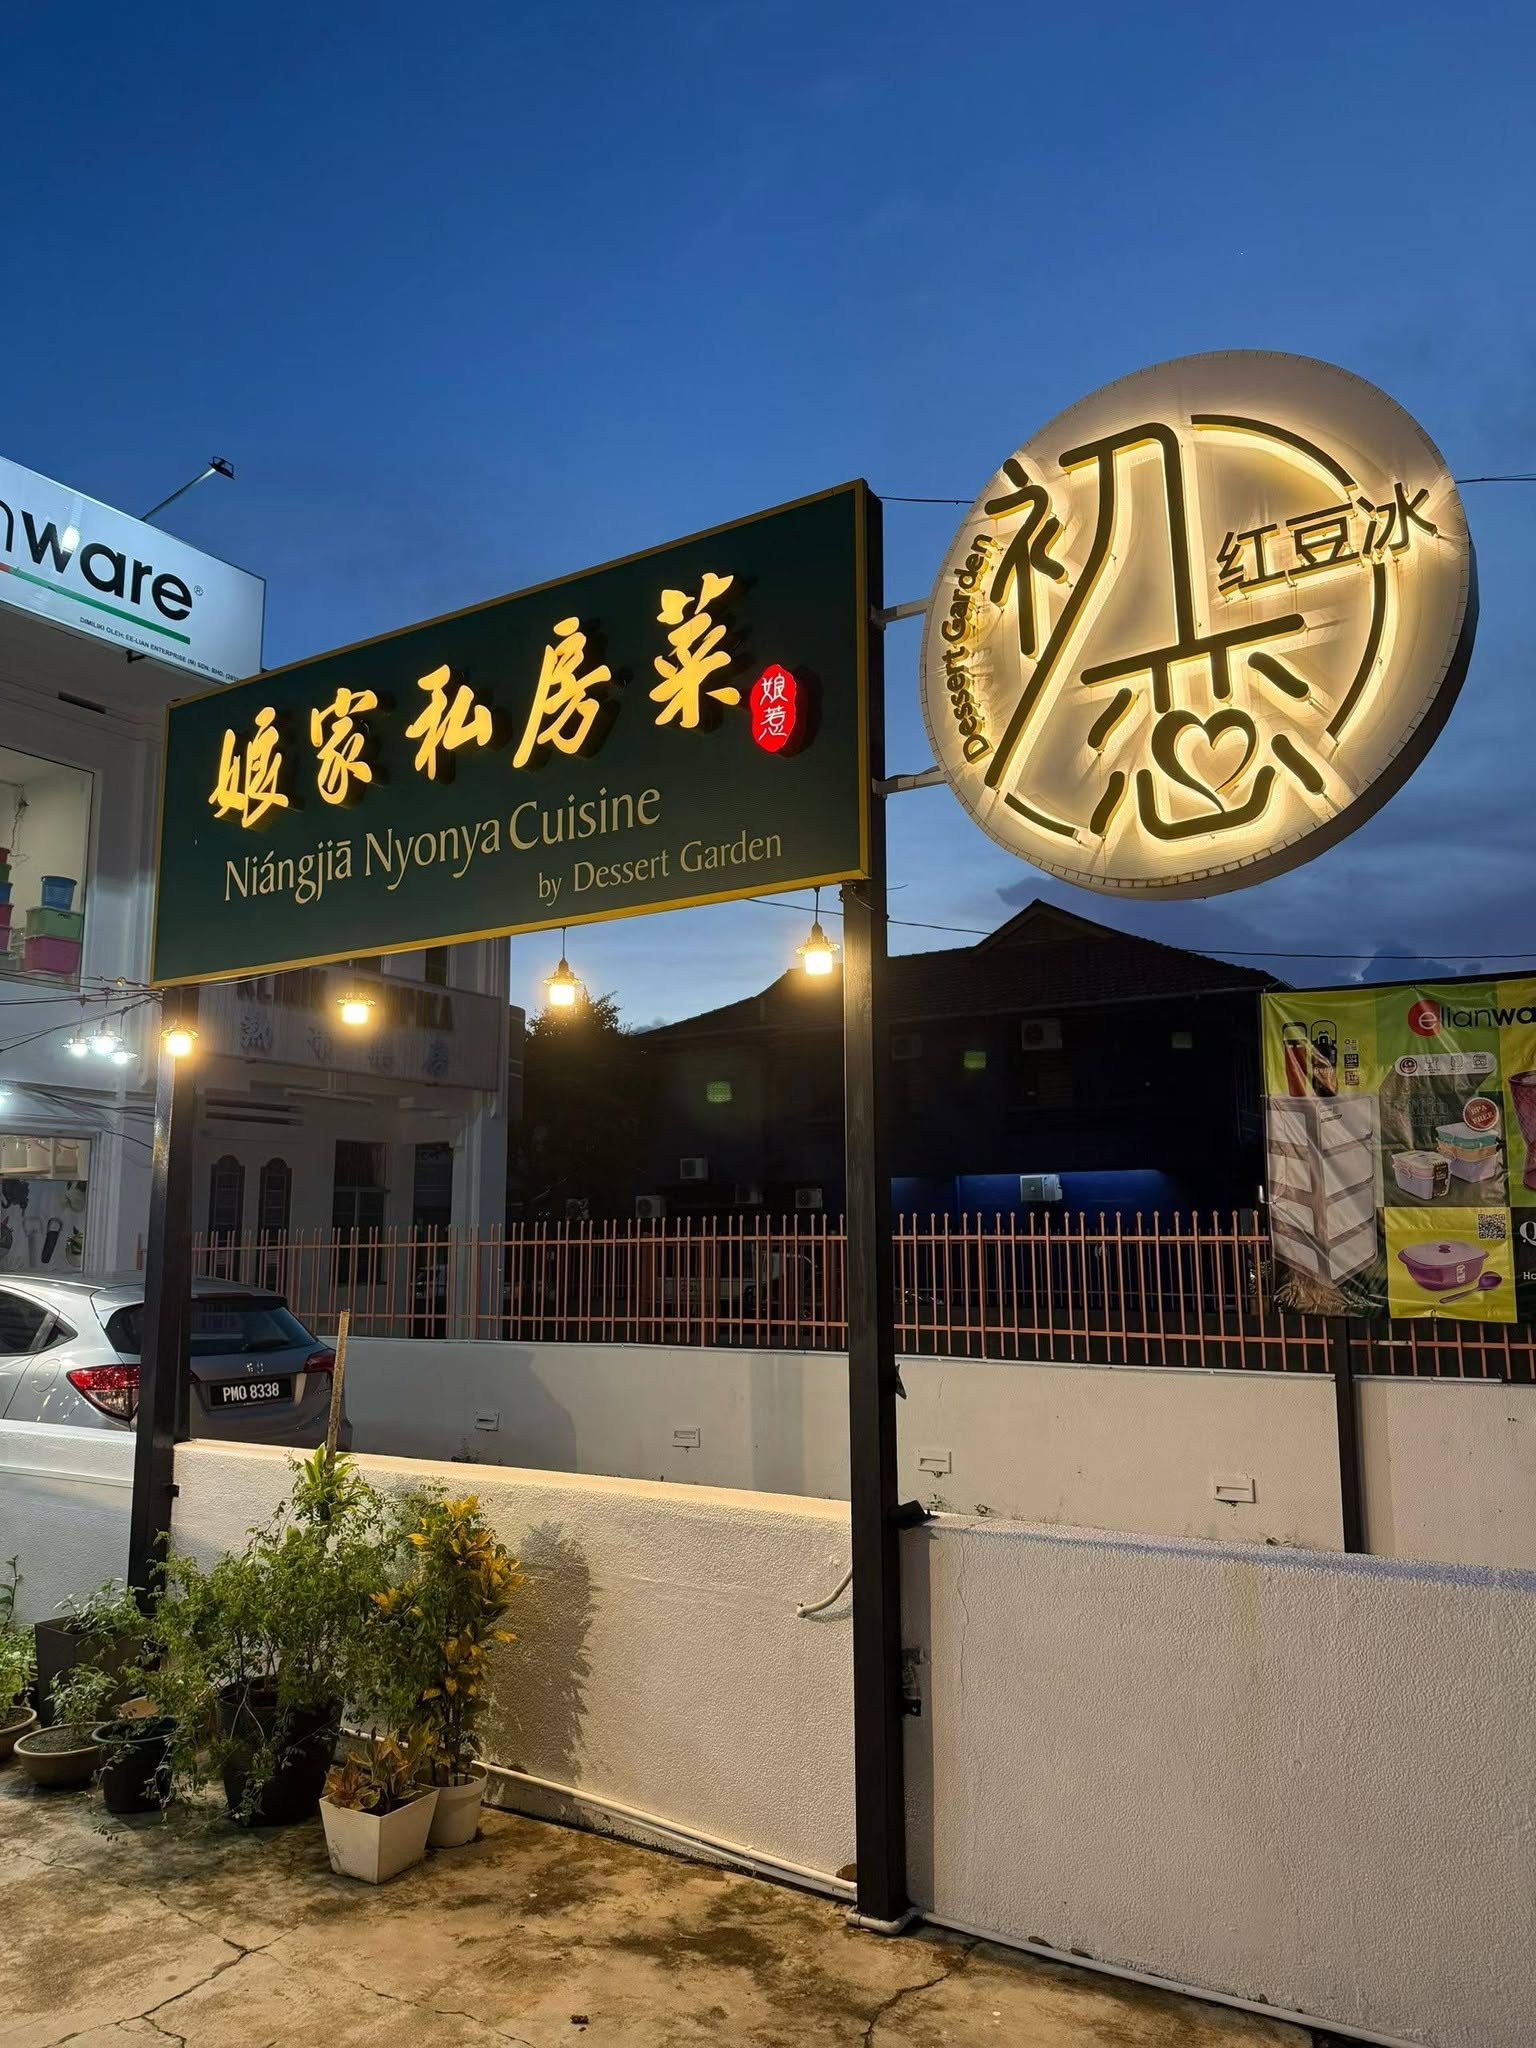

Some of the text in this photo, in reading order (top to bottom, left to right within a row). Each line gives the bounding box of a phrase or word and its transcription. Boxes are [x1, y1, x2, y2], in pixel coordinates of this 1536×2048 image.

[1216, 482, 1437, 592] 红豆冰
[126, 634, 149, 648] EE-LIAN
[150, 643, 187, 663] ENTERPRISE
[941, 533, 994, 764] Dessert Garden
[207, 572, 741, 829] 娘家私房菜
[759, 673, 788, 741] 娘惹
[224, 787, 661, 904] Niángjiā Nyonya Cuisine
[538, 830, 782, 907] by Dessert Garden
[1471, 1105, 1487, 1114] BPA
[1472, 1112, 1494, 1124] FREE
[223, 1382, 279, 1402] PMQ 8338
